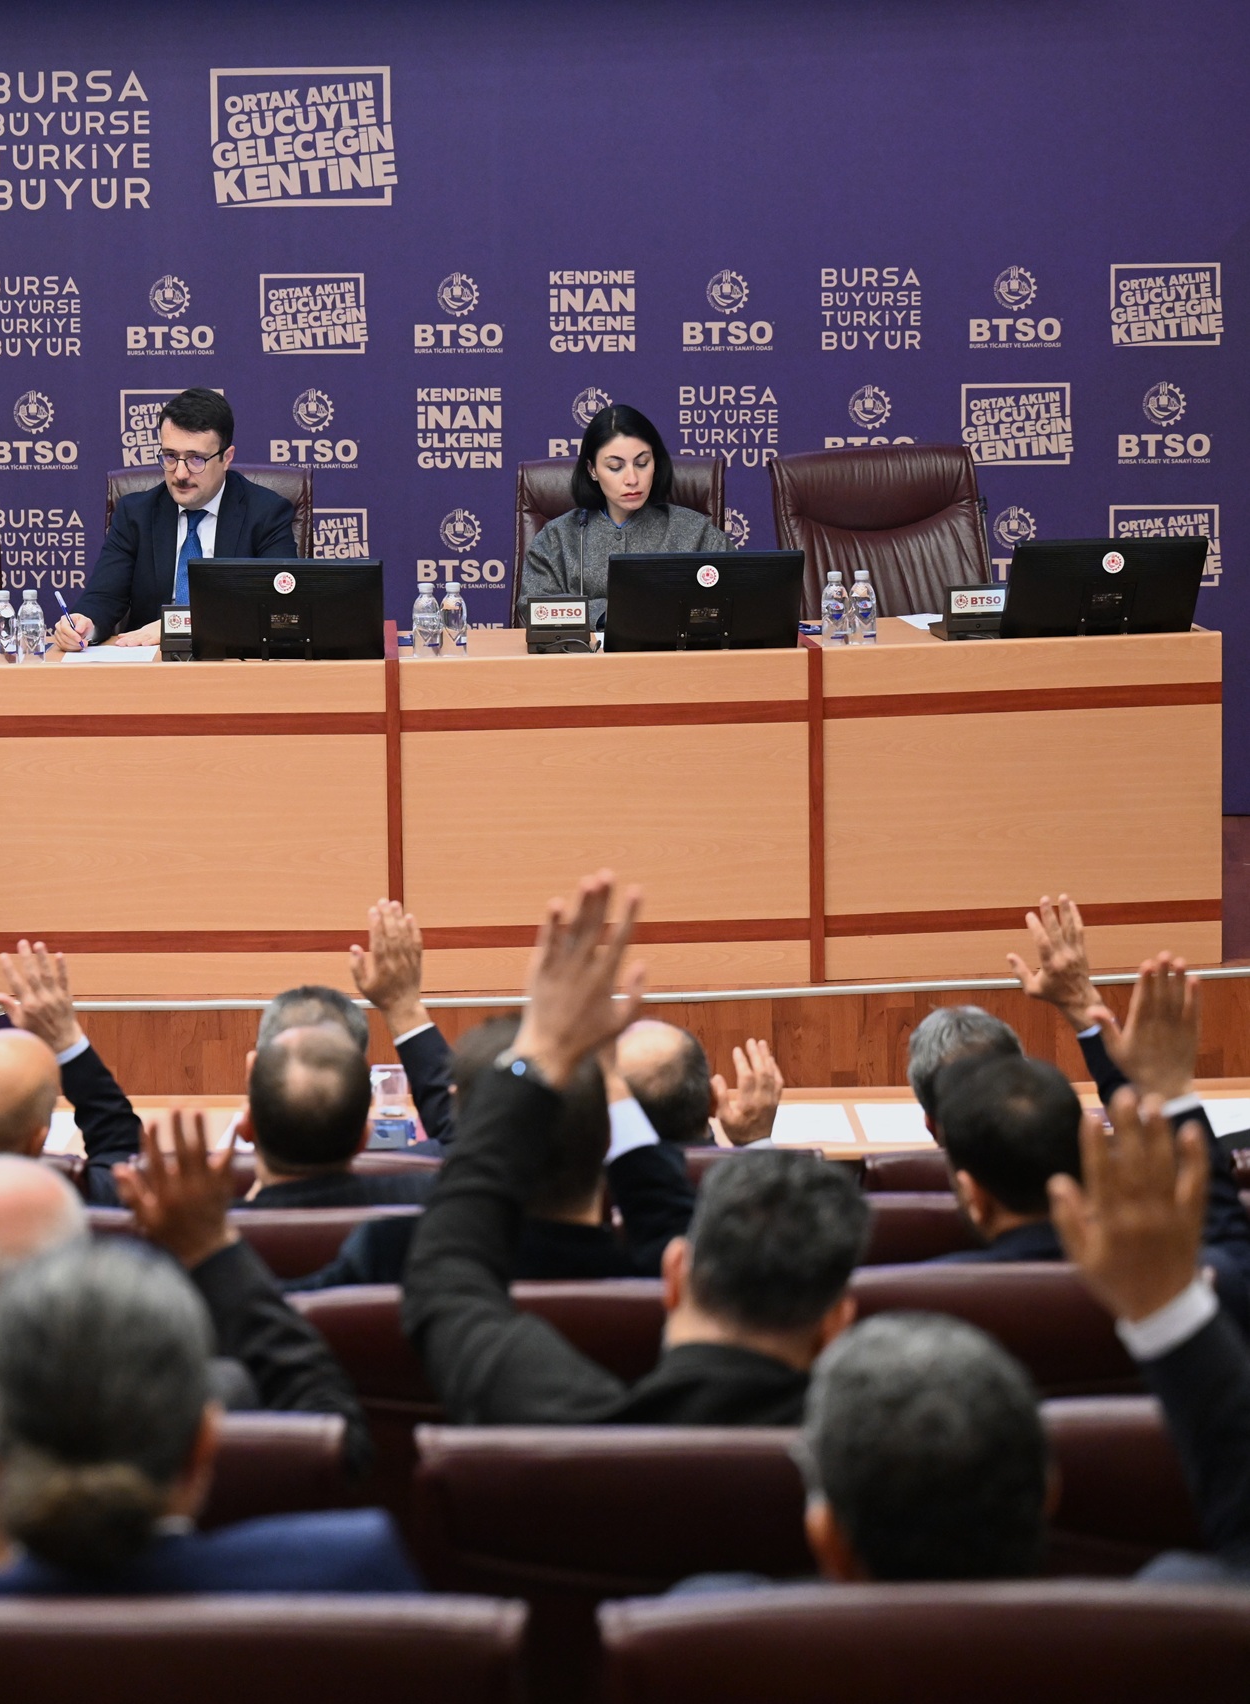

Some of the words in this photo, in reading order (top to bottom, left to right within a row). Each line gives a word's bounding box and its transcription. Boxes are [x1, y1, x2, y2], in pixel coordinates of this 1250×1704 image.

[225, 89, 300, 113] ORTAK
[306, 81, 373, 105] AKLIN
[227, 100, 376, 139] GÜCÜYLE
[213, 124, 394, 168] GELECEĞİN
[213, 152, 398, 204] KENTİNE
[550, 270, 635, 284] KENDİNE
[821, 268, 920, 287] BURSA
[1119, 276, 1165, 290] ORTAK
[1169, 272, 1210, 286] AKLIN
[268, 286, 312, 300] ORTAK
[315, 282, 354, 295] AKLIN
[550, 288, 635, 312] İNAN
[822, 291, 921, 306] BÜYÜRSE
[1121, 283, 1211, 306] GÜCÜYLE
[270, 292, 356, 315] GÜCÜYLE
[1111, 297, 1222, 323] GELECEĞİN
[261, 306, 366, 332] GELECEĞİN
[550, 316, 635, 331] ÜLKENE
[822, 311, 921, 326] TÜRKİYE
[127, 326, 214, 349] BTSO
[261, 322, 368, 352] KENTİNE
[414, 324, 503, 347] BTSO
[683, 321, 772, 344] BTSO
[970, 318, 1060, 341] BTSO
[1111, 314, 1224, 344] KENTİNE
[550, 335, 635, 352] GÜVEN
[822, 331, 920, 350] BÜYÜR
[417, 388, 501, 401] KENDİNE
[680, 386, 777, 405] BURSA
[970, 396, 1015, 410] ORTAK
[1019, 391, 1060, 406] AKLIN
[128, 402, 167, 416] ORTA
[417, 405, 501, 429] İNAN
[680, 410, 778, 424] BÜYÜRSE
[971, 403, 1061, 425] GÜCÜYLE
[680, 429, 778, 444] TÜRKİYE
[962, 417, 1072, 443] GELECEĞİN
[418, 433, 502, 448] ÜLKENE
[962, 433, 1074, 463] KENTİNE
[1118, 434, 1210, 457] BTSO
[270, 439, 357, 462] BTSO
[418, 452, 502, 468] GÜVEN
[318, 517, 357, 530] AKLIN
[1118, 517, 1164, 532] ORTAK
[1167, 513, 1209, 528] AKLIN
[0, 533, 84, 546] ÜYÜRSE
[1, 551, 85, 565] ÜRKİYE
[417, 560, 505, 582] BTSO
[971, 595, 1001, 605] BTSO
[551, 608, 582, 617] BTSO
